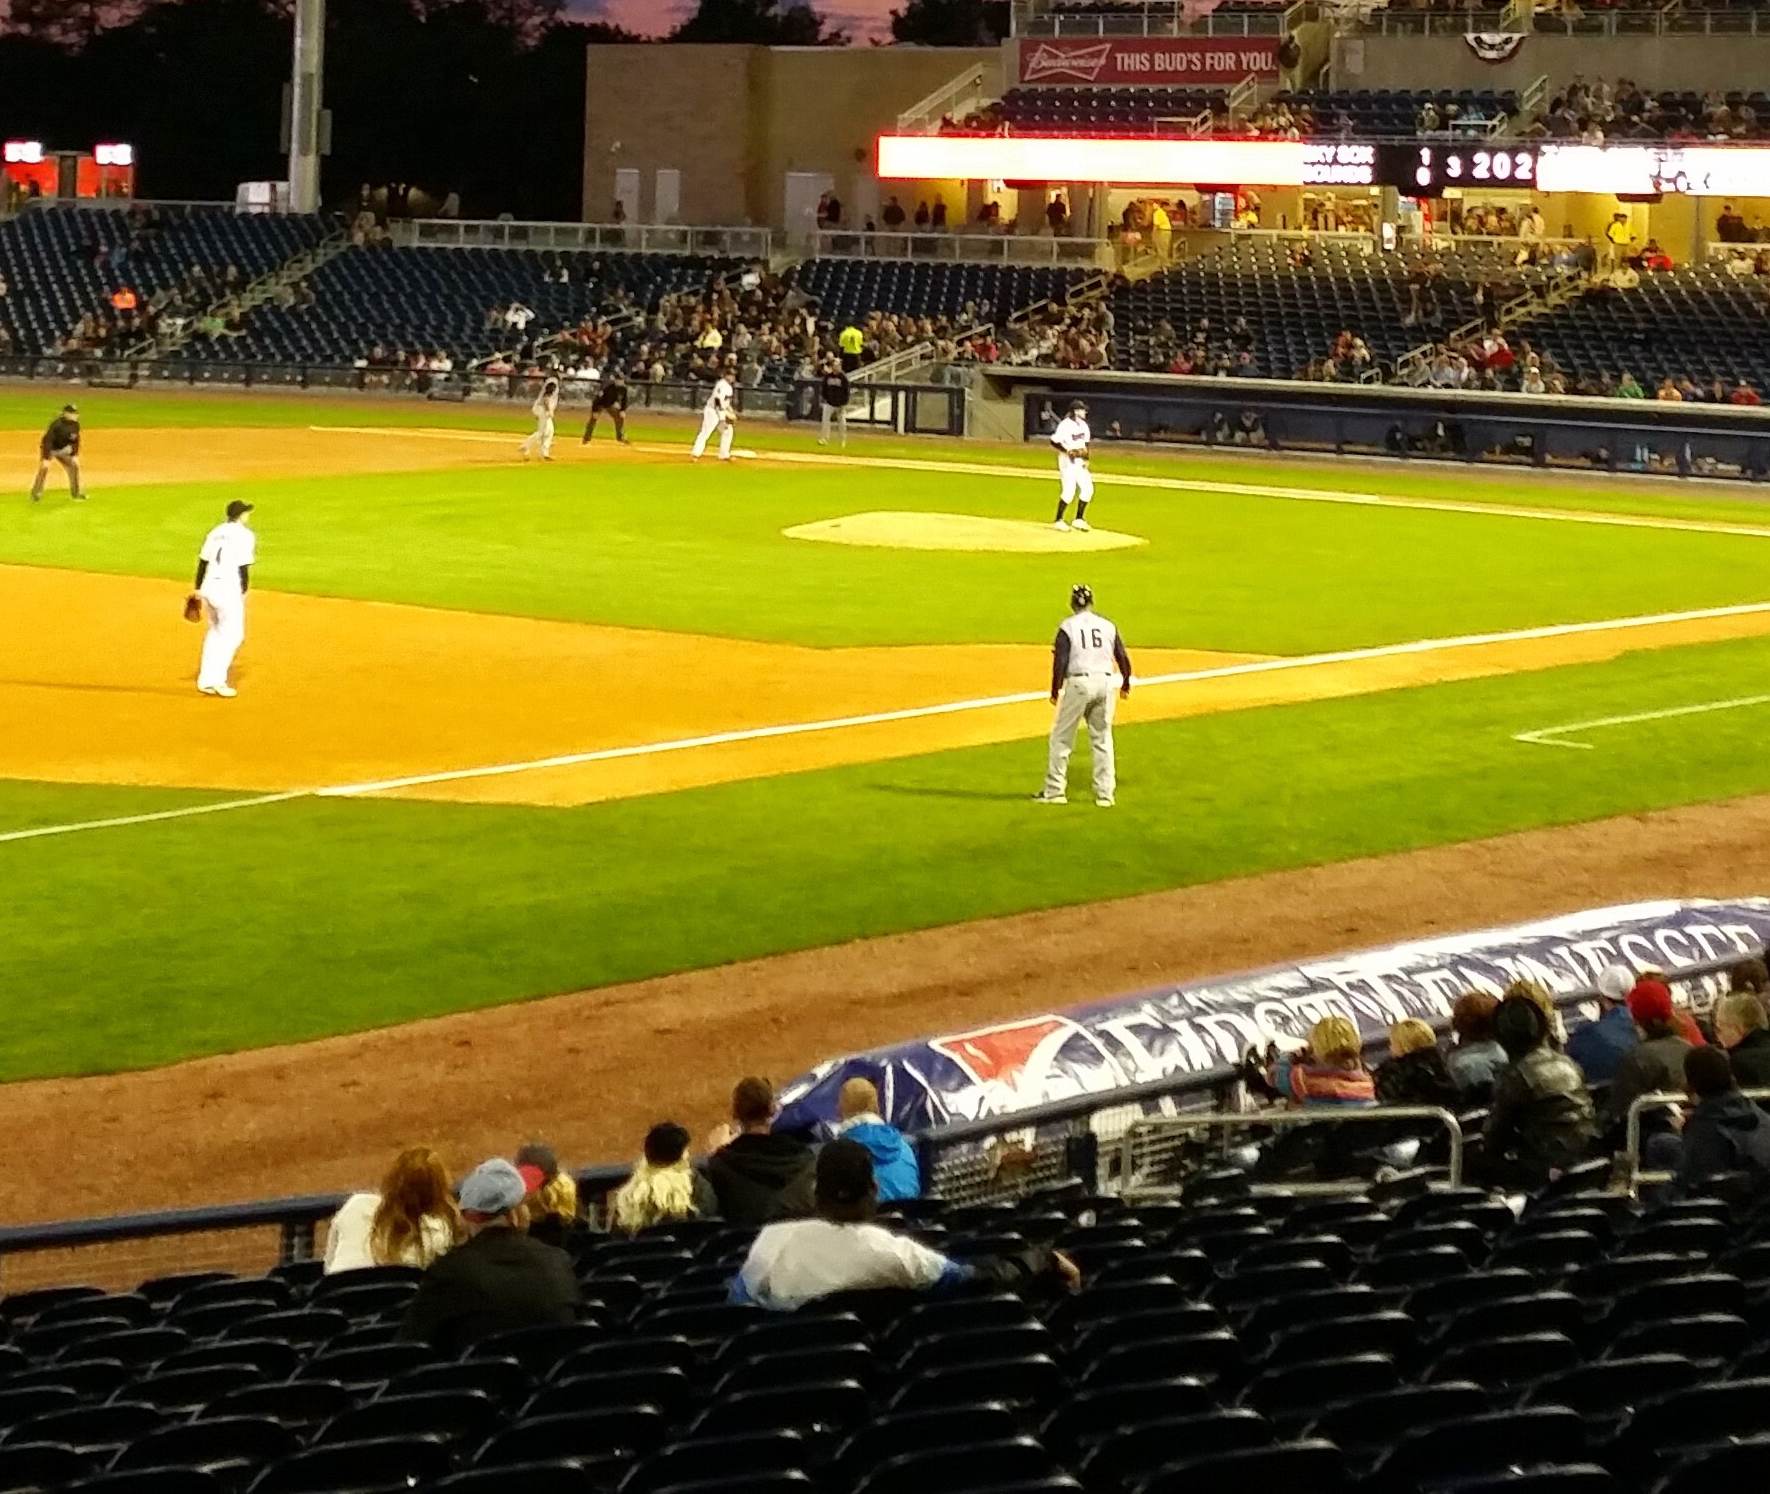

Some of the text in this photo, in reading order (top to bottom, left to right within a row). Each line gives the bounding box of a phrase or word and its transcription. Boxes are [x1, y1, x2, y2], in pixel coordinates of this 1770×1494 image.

[1115, 52, 1277, 72] THIS BUD'S FOR YOU.
[1419, 147, 1431, 166] 1
[1446, 155, 1462, 178] 3
[1080, 628, 1102, 649] 16
